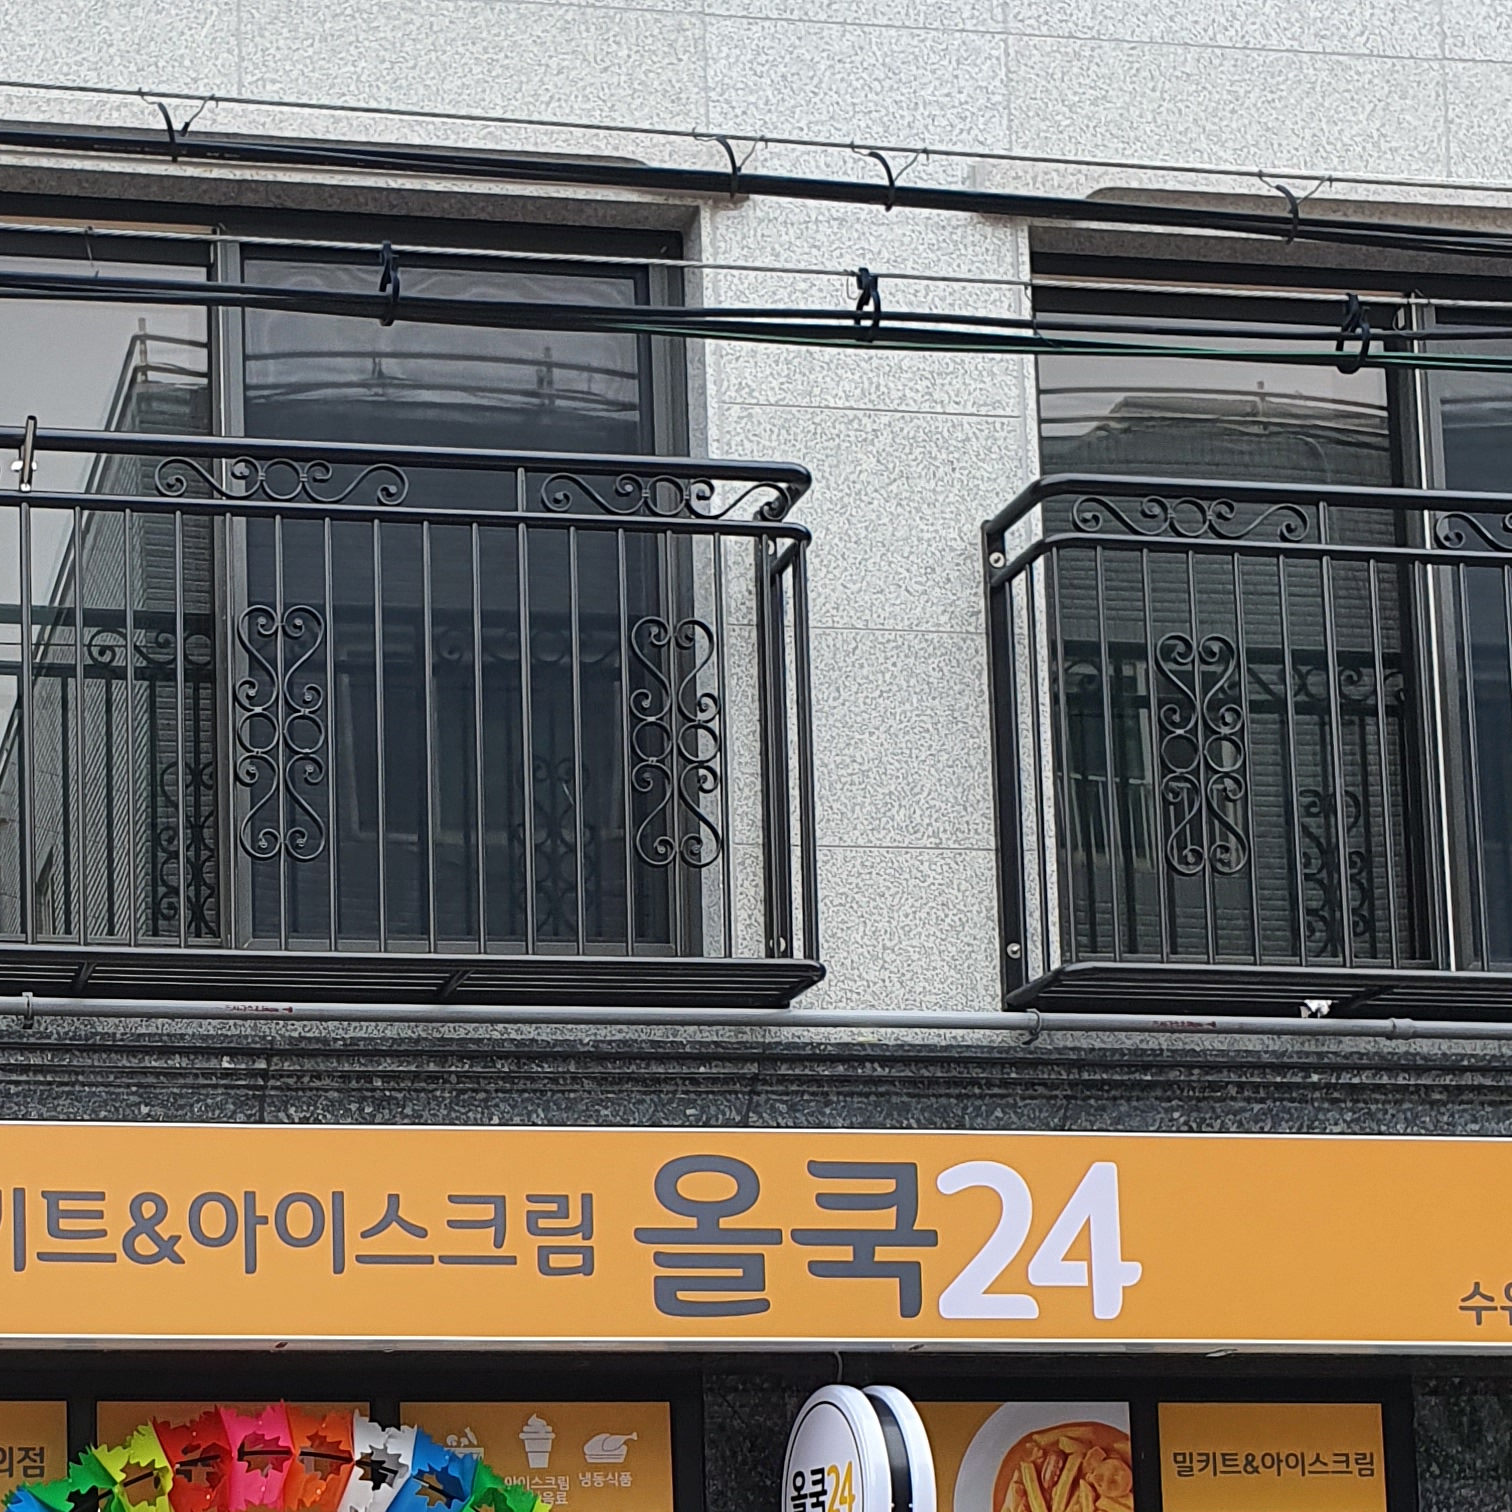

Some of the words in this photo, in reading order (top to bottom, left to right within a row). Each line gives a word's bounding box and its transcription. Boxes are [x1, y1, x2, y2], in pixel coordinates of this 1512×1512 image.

[633, 1154, 1143, 1320] 올쿡24
[1173, 1451, 1375, 1478] 밀키트&아이스크림
[579, 1472, 632, 1487] 냉동식품
